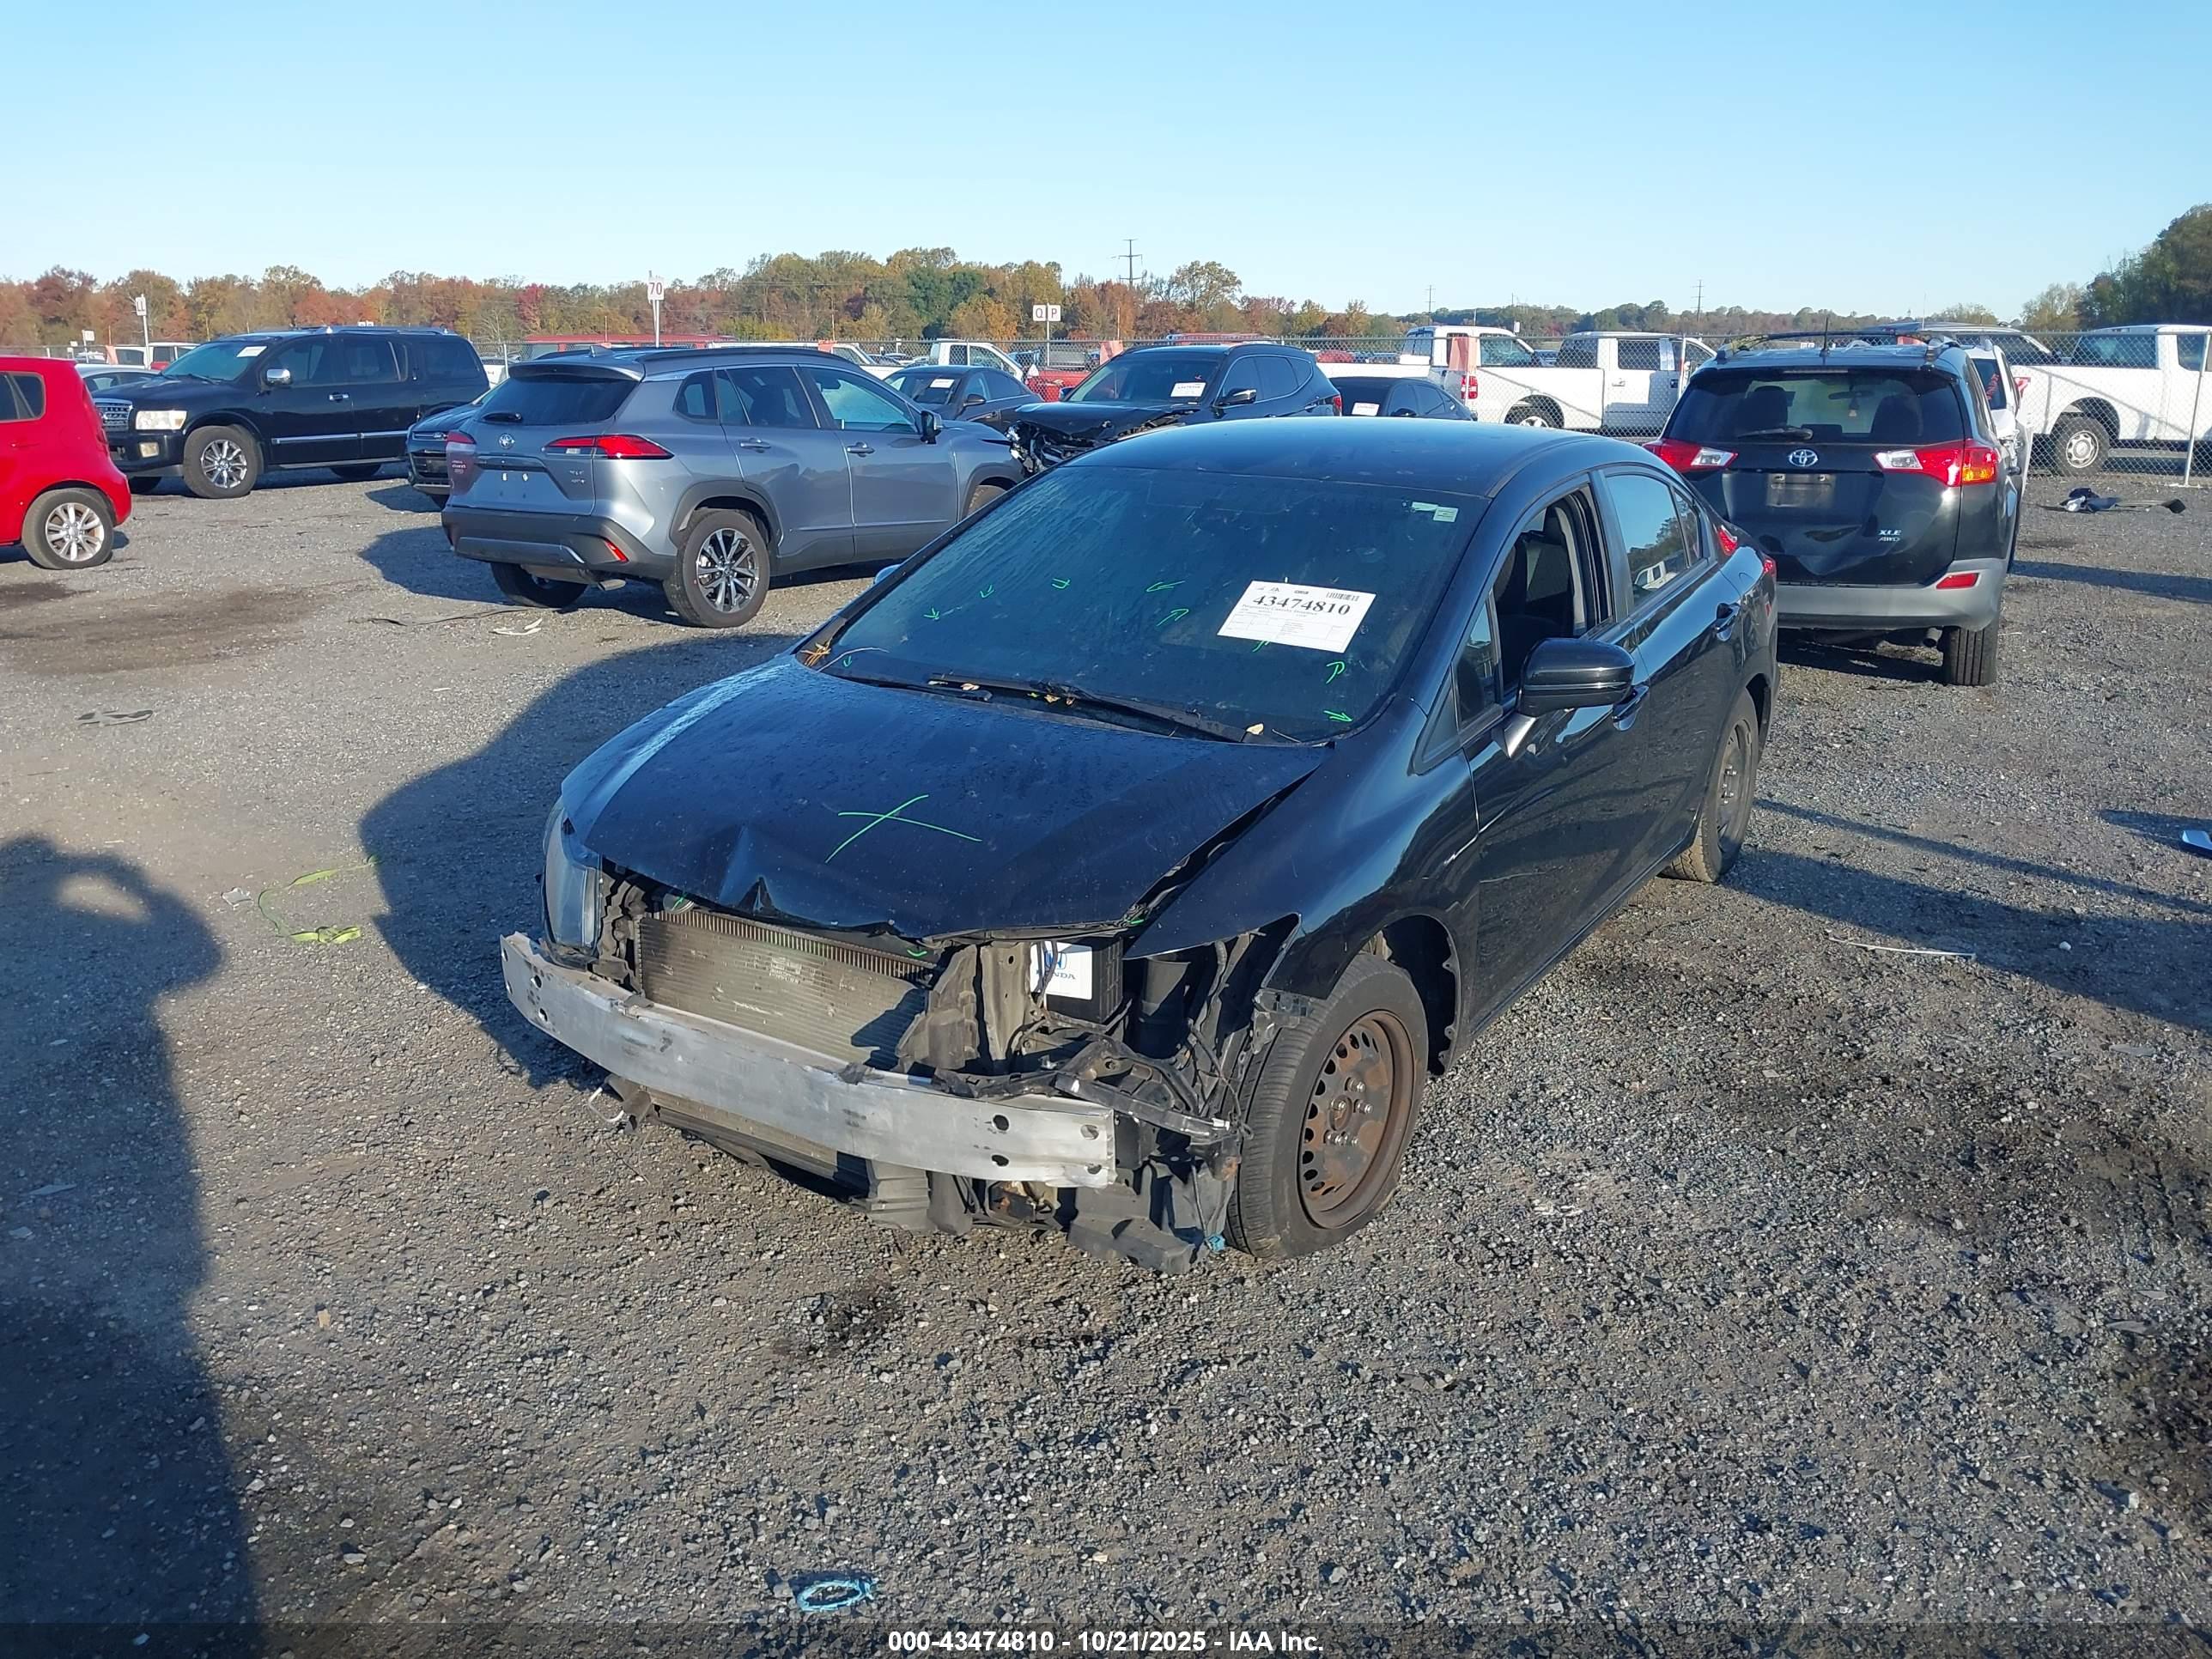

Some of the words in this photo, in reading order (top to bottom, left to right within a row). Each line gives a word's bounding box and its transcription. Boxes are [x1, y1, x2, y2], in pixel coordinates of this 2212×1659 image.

[648, 282, 663, 295] 70
[1035, 307, 1044, 319] Q
[1051, 307, 1058, 319] P
[1252, 594, 1352, 616] 43474810
